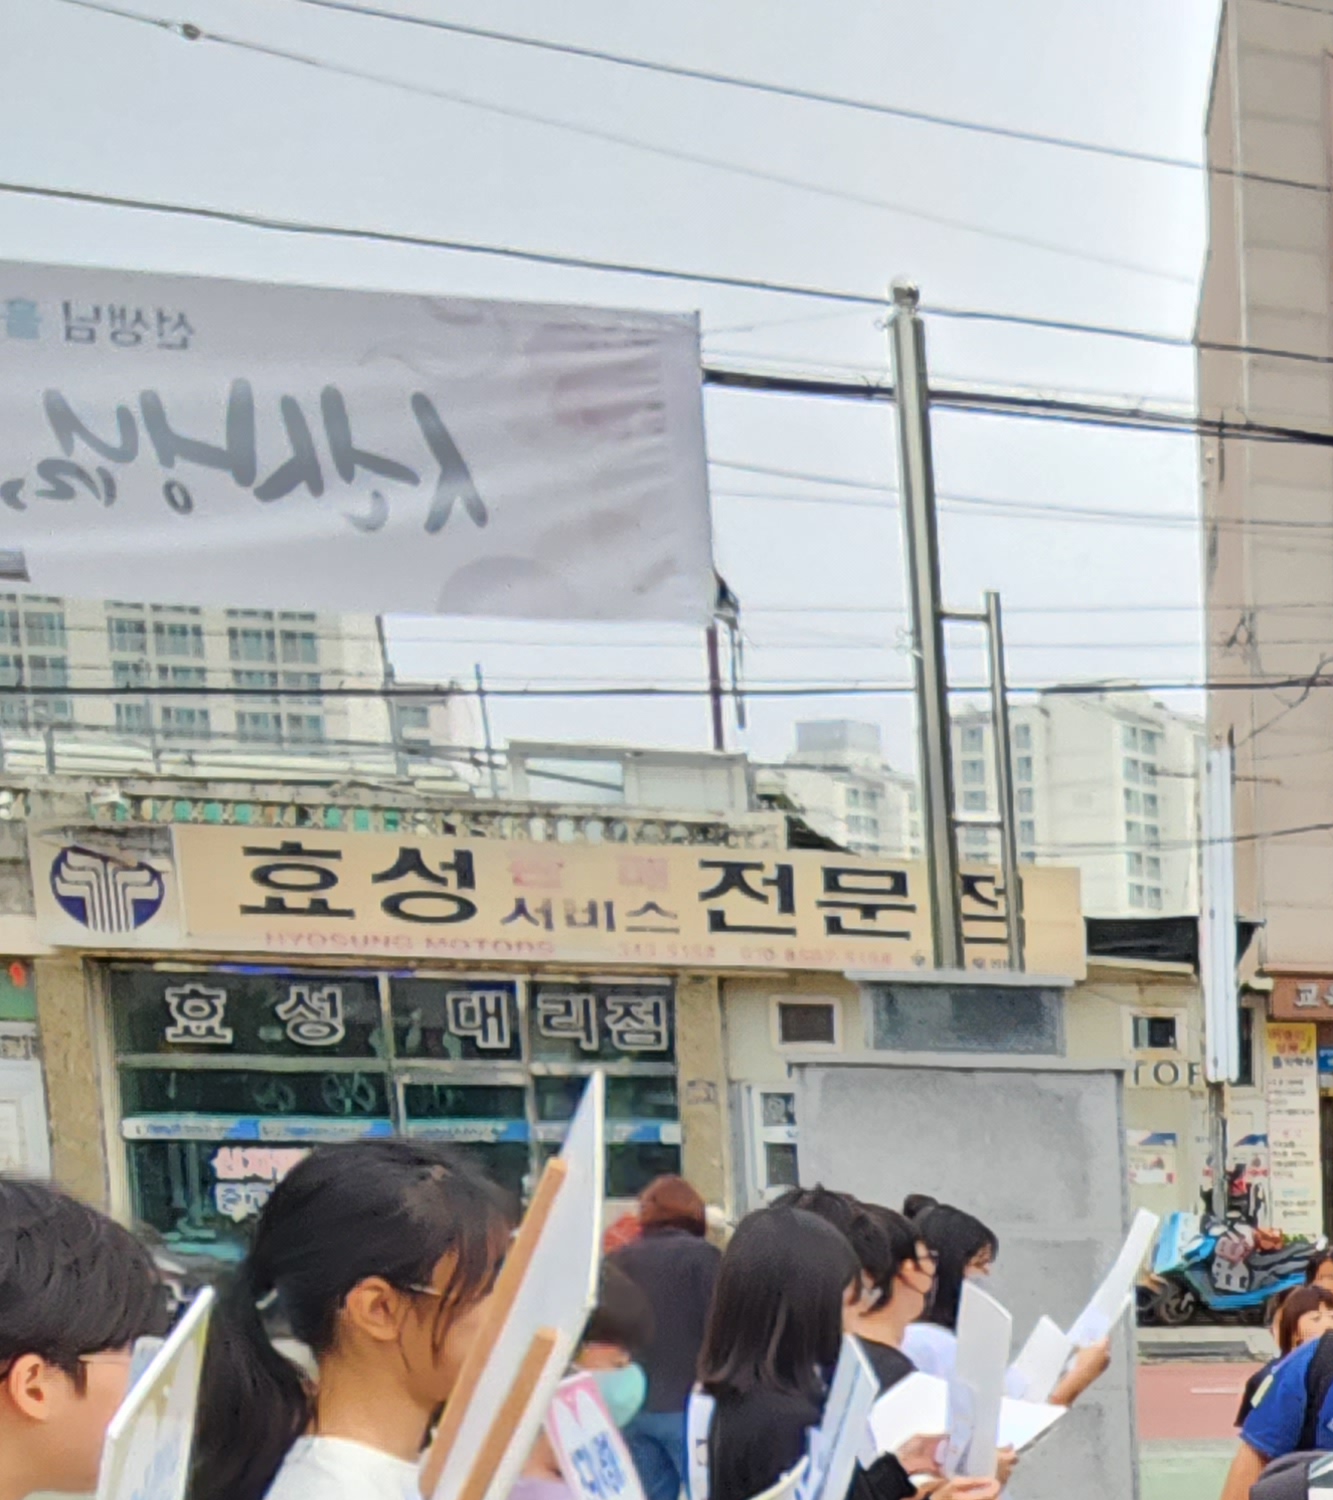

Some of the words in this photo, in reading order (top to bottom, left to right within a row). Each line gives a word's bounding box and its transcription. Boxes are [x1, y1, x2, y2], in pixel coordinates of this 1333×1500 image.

[240, 840, 478, 924] 효성
[698, 859, 1024, 945] 전문점
[501, 896, 680, 934] 서비스
[165, 983, 346, 1047] 효성
[446, 988, 669, 1052] 대리점
